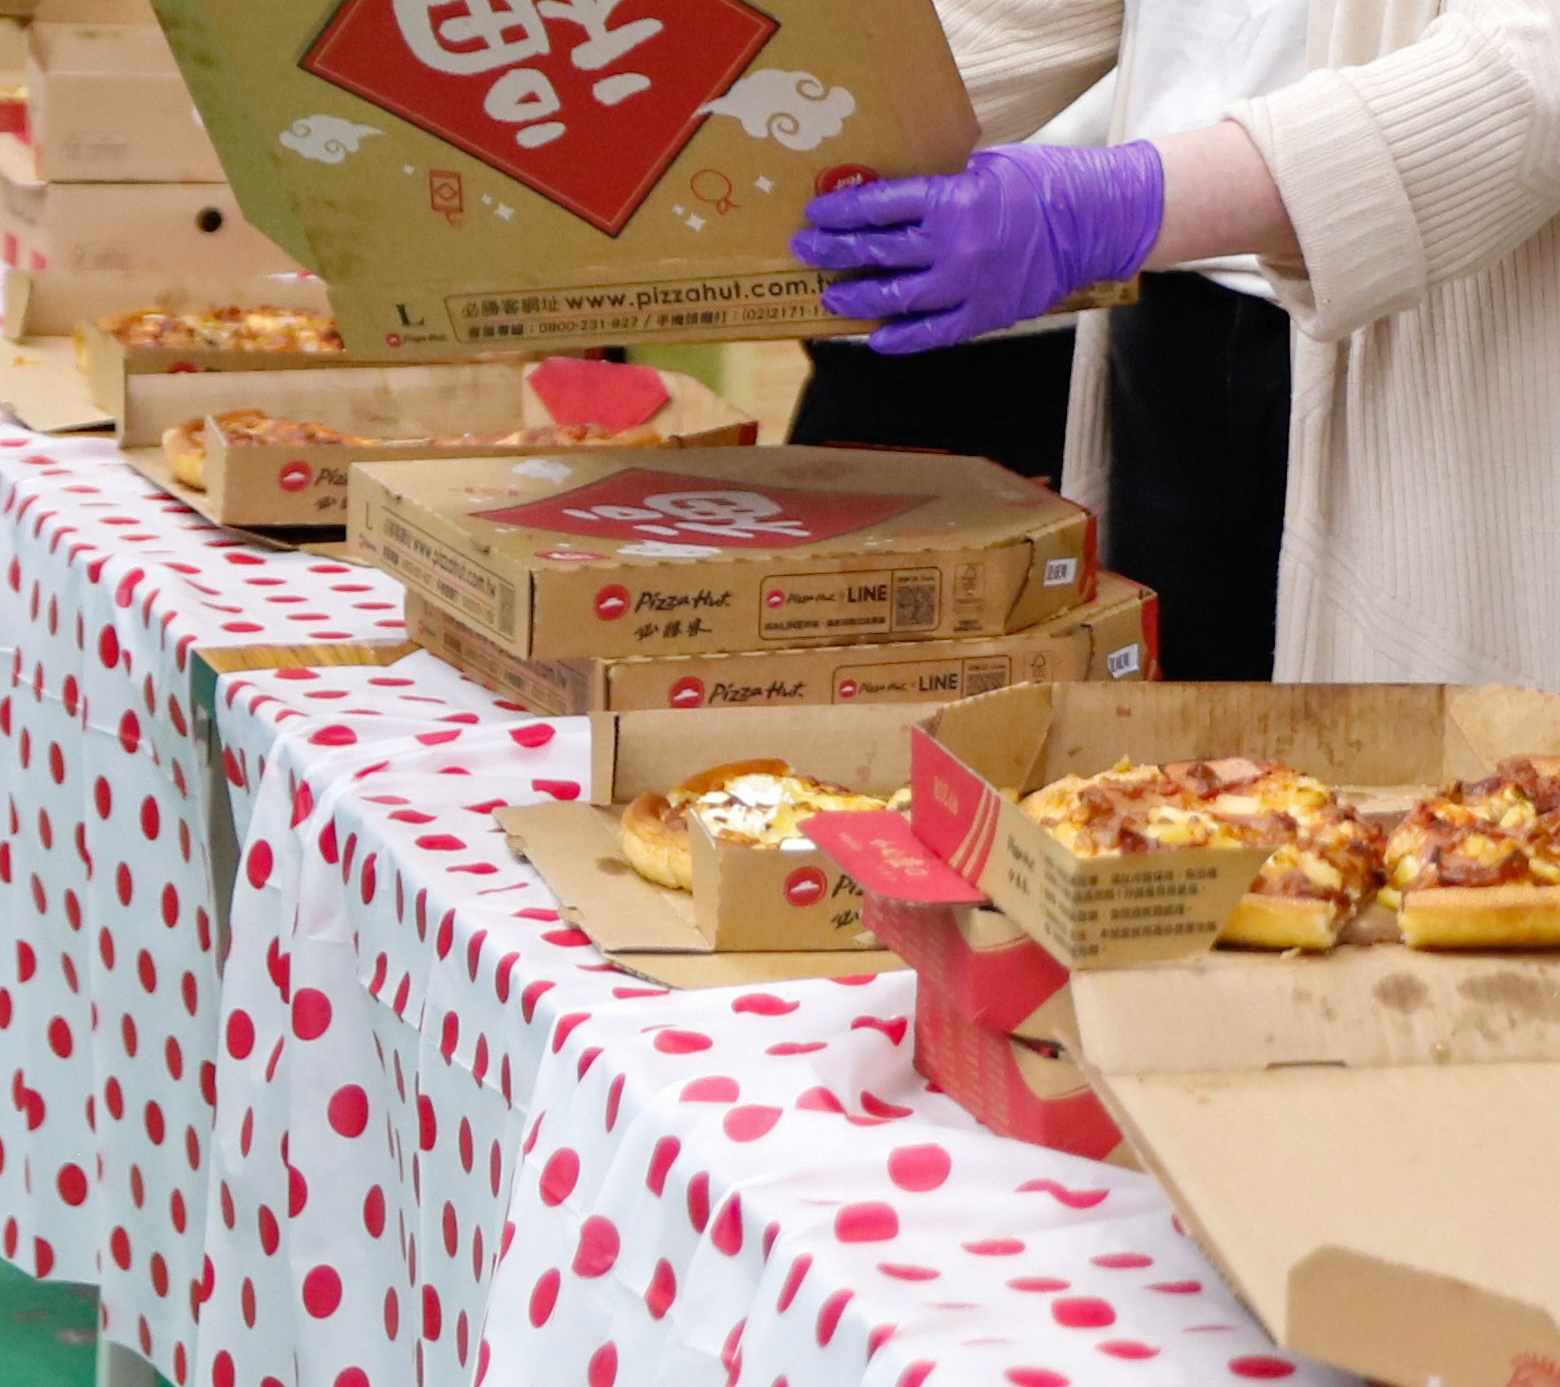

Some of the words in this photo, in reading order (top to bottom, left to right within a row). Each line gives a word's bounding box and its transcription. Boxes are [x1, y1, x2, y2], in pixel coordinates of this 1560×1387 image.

[395, 303, 425, 327] L
[634, 589, 690, 613] Pizza
[847, 584, 887, 604] LINE
[708, 682, 763, 704] Pizza
[918, 673, 959, 693] LINE
